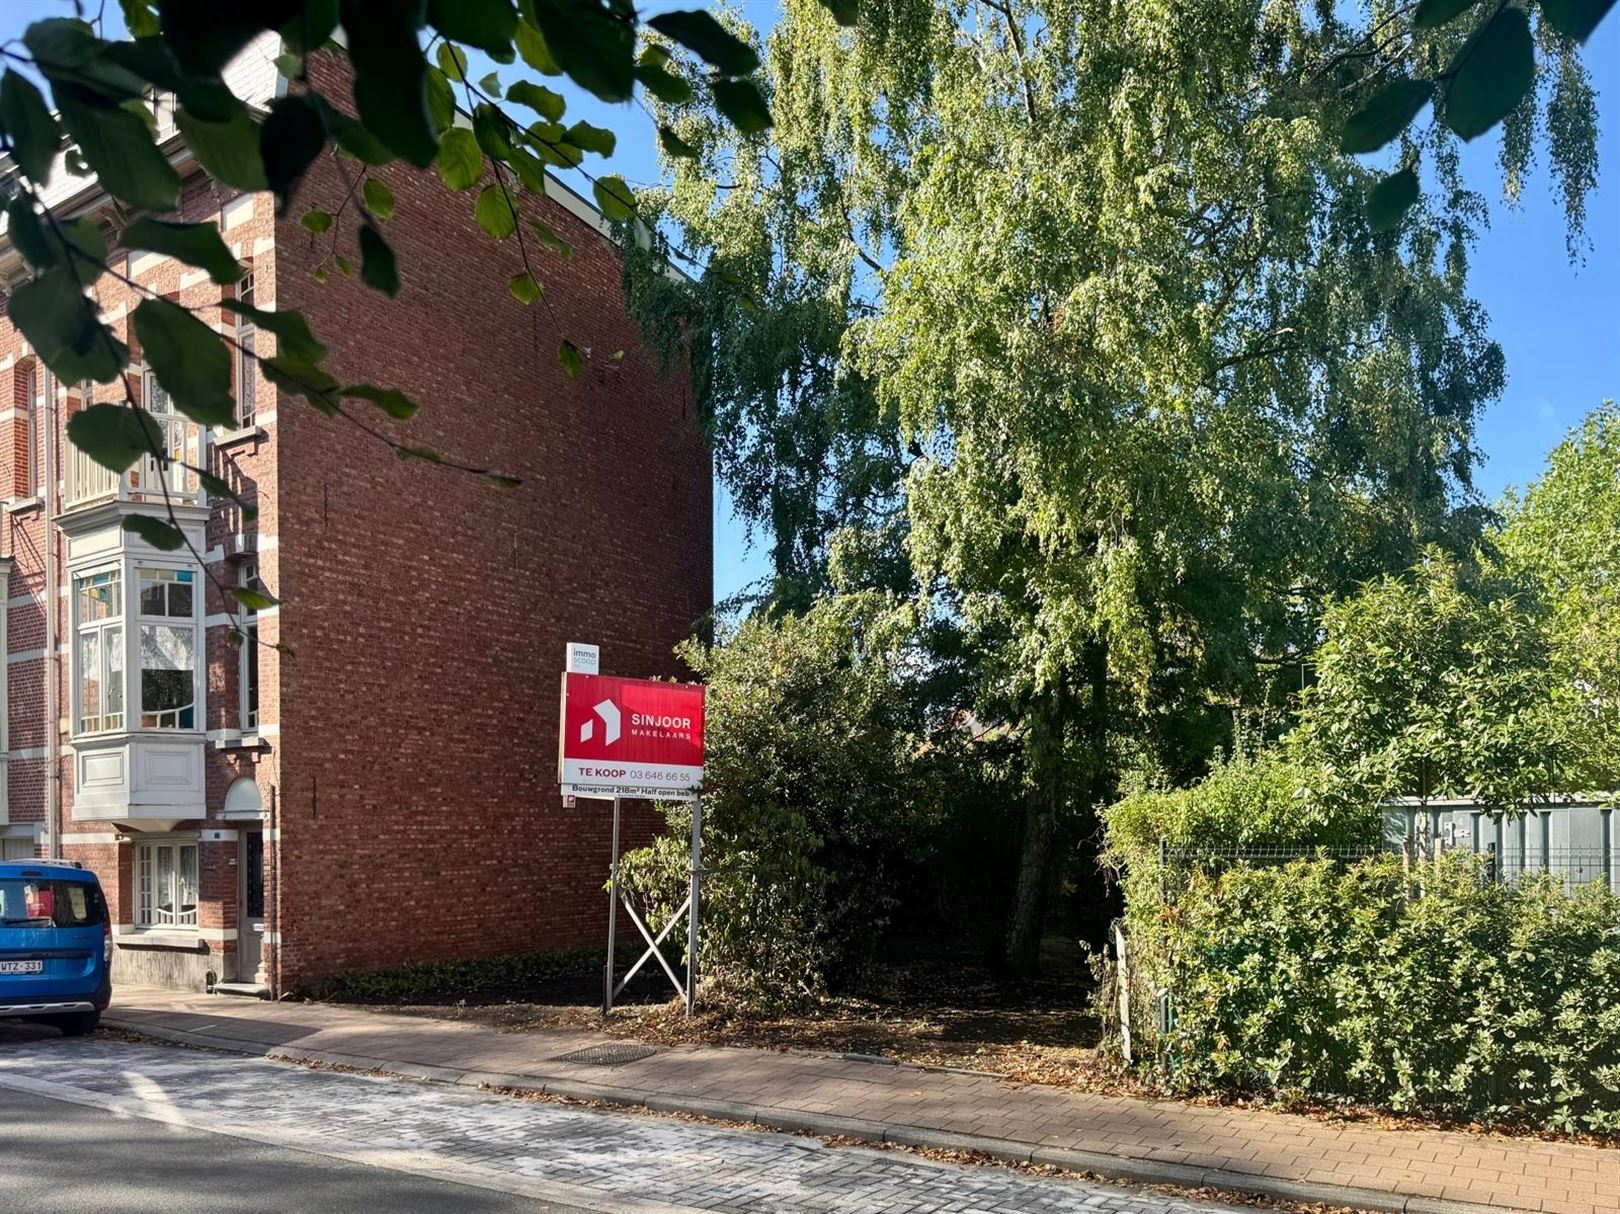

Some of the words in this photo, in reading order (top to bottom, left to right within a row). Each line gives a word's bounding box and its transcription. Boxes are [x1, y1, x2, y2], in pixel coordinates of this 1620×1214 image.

[573, 648, 597, 659] immo
[631, 713, 691, 730] SINJOOR
[631, 729, 691, 740] MAKELAARS
[578, 767, 593, 777] TE
[595, 768, 626, 778] KOOP
[630, 769, 643, 780] 03
[645, 770, 663, 780] 646
[665, 771, 678, 781] 66
[679, 772, 690, 782] 55
[572, 784, 614, 794] Bouwgrond
